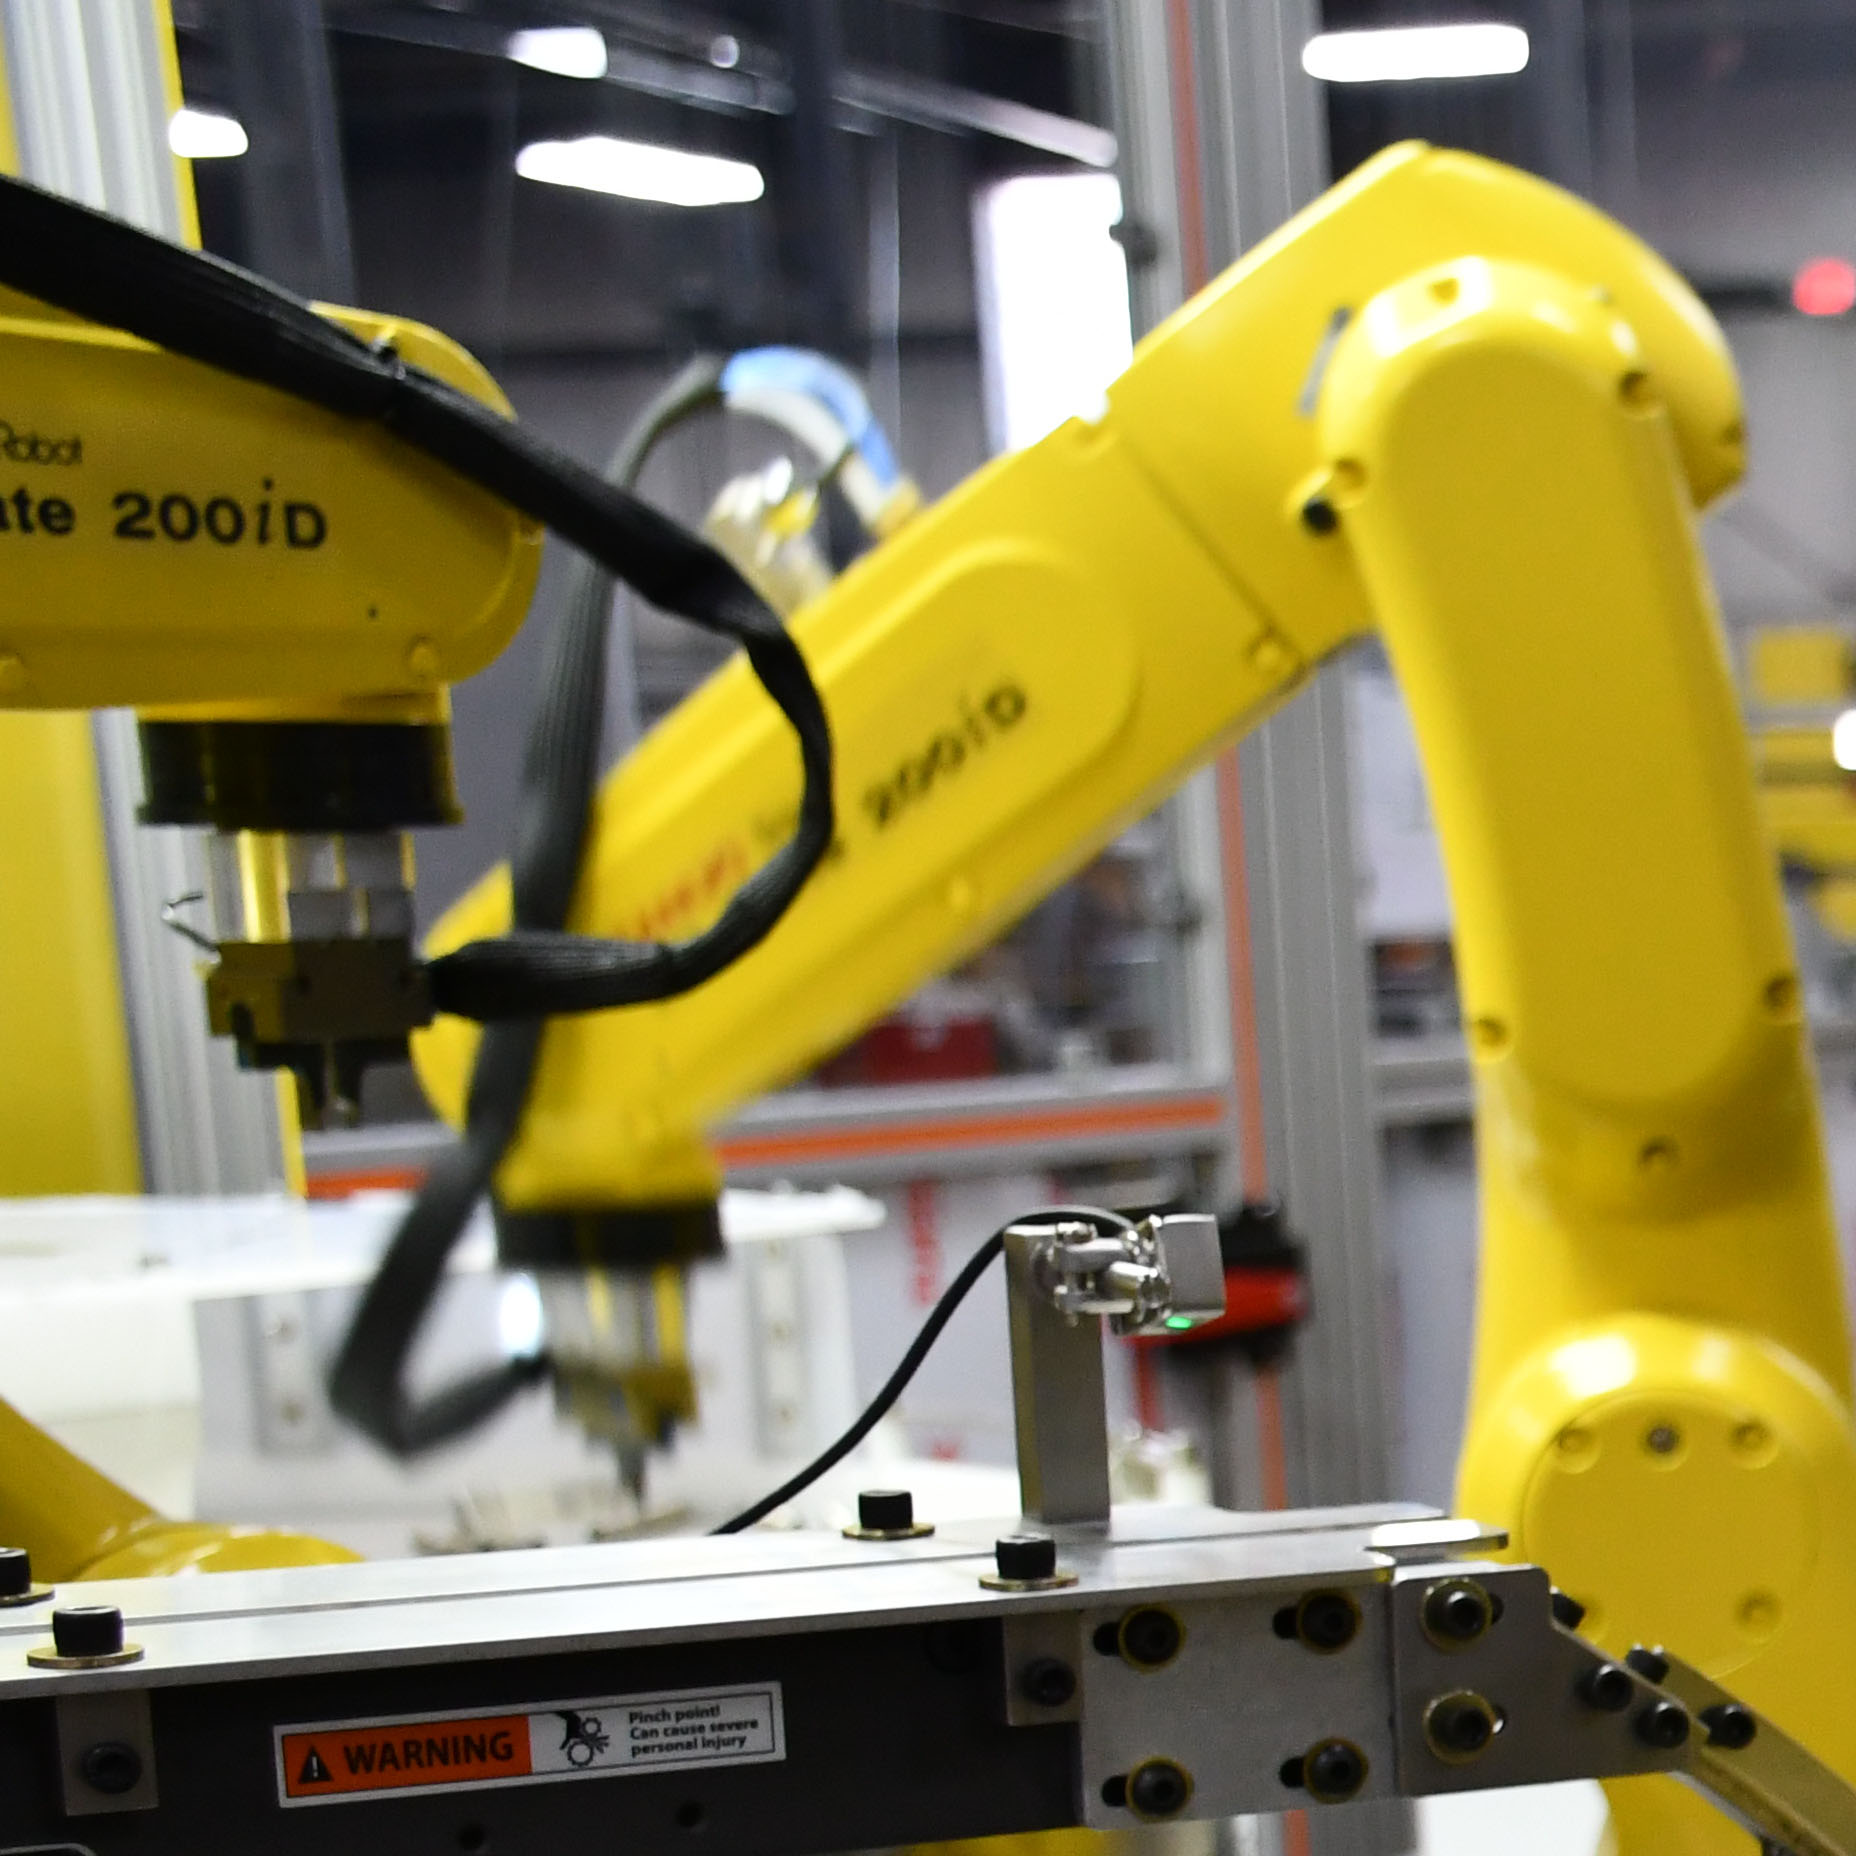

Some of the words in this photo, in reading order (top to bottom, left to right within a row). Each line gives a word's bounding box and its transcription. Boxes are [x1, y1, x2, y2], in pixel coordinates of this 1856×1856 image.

[111, 476, 327, 550] 200iD
[628, 1708, 672, 1725] Pinch
[674, 1704, 721, 1723] point!
[630, 1727, 660, 1740] Can
[663, 1723, 706, 1738] cause
[709, 1719, 759, 1733] severe
[344, 1731, 516, 1776] WARNING
[631, 1738, 698, 1758] personal
[701, 1735, 747, 1751] injury
